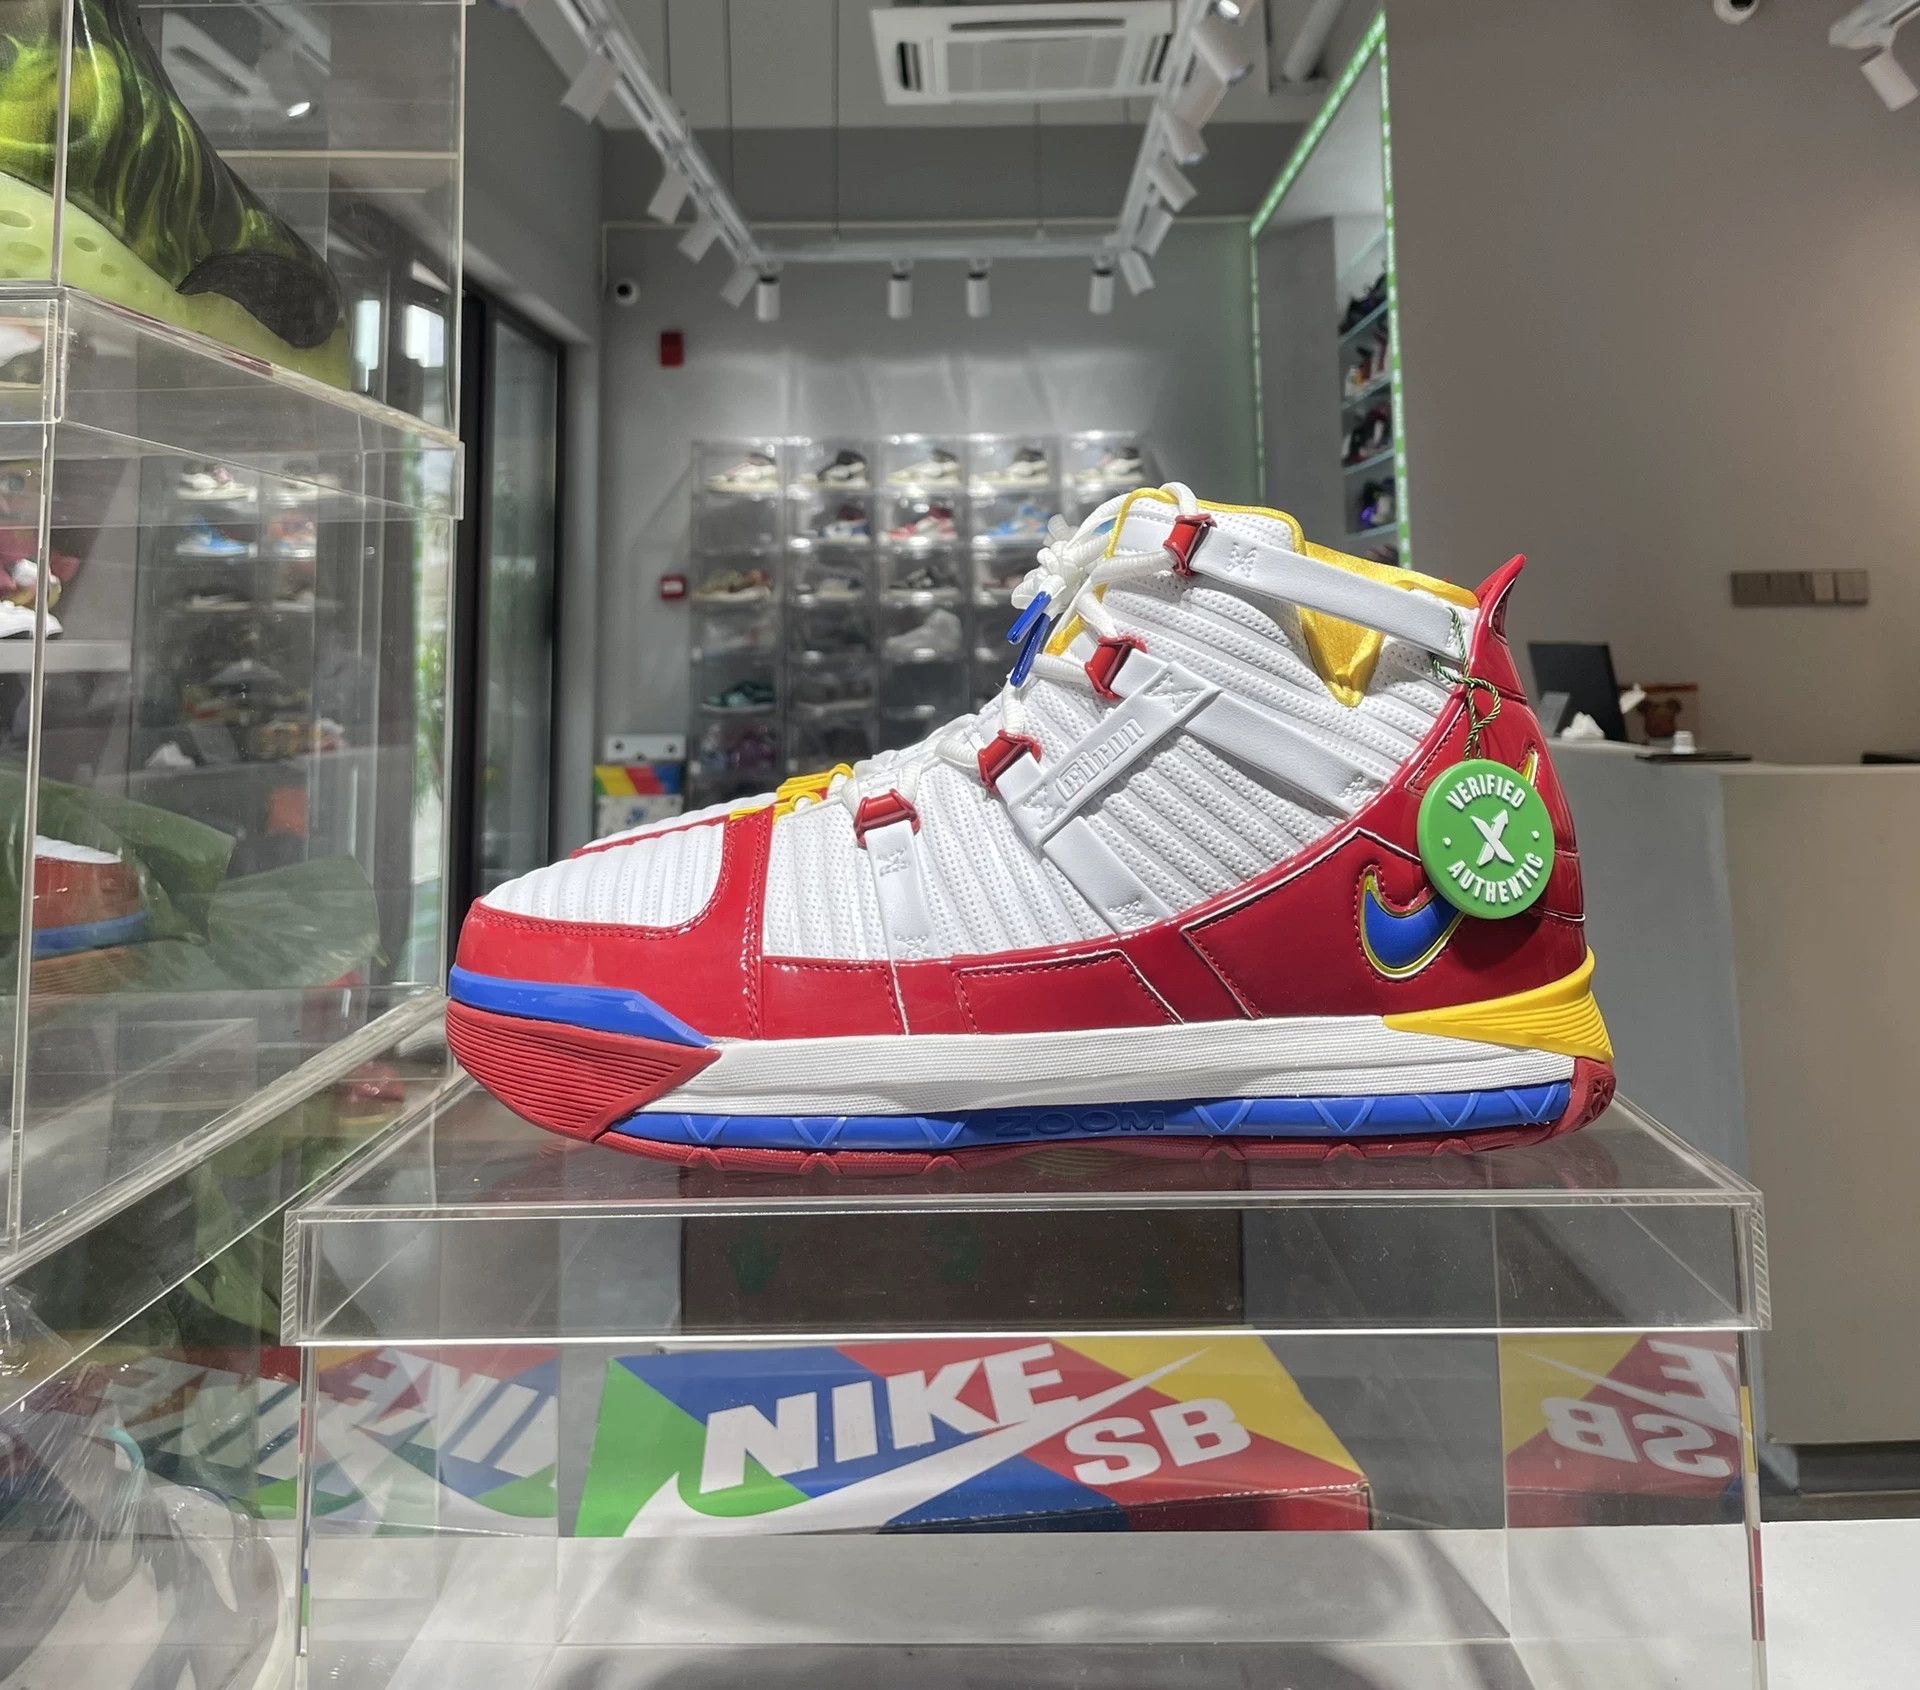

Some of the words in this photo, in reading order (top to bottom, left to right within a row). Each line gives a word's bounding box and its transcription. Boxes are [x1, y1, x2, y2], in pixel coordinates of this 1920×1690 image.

[1445, 773, 1527, 811] VERIFIED
[1447, 852, 1544, 904] AUTHENTIC
[996, 1110, 1165, 1137] ZOOM
[699, 1342, 1078, 1494] NIKE
[1064, 1397, 1251, 1485] SB
